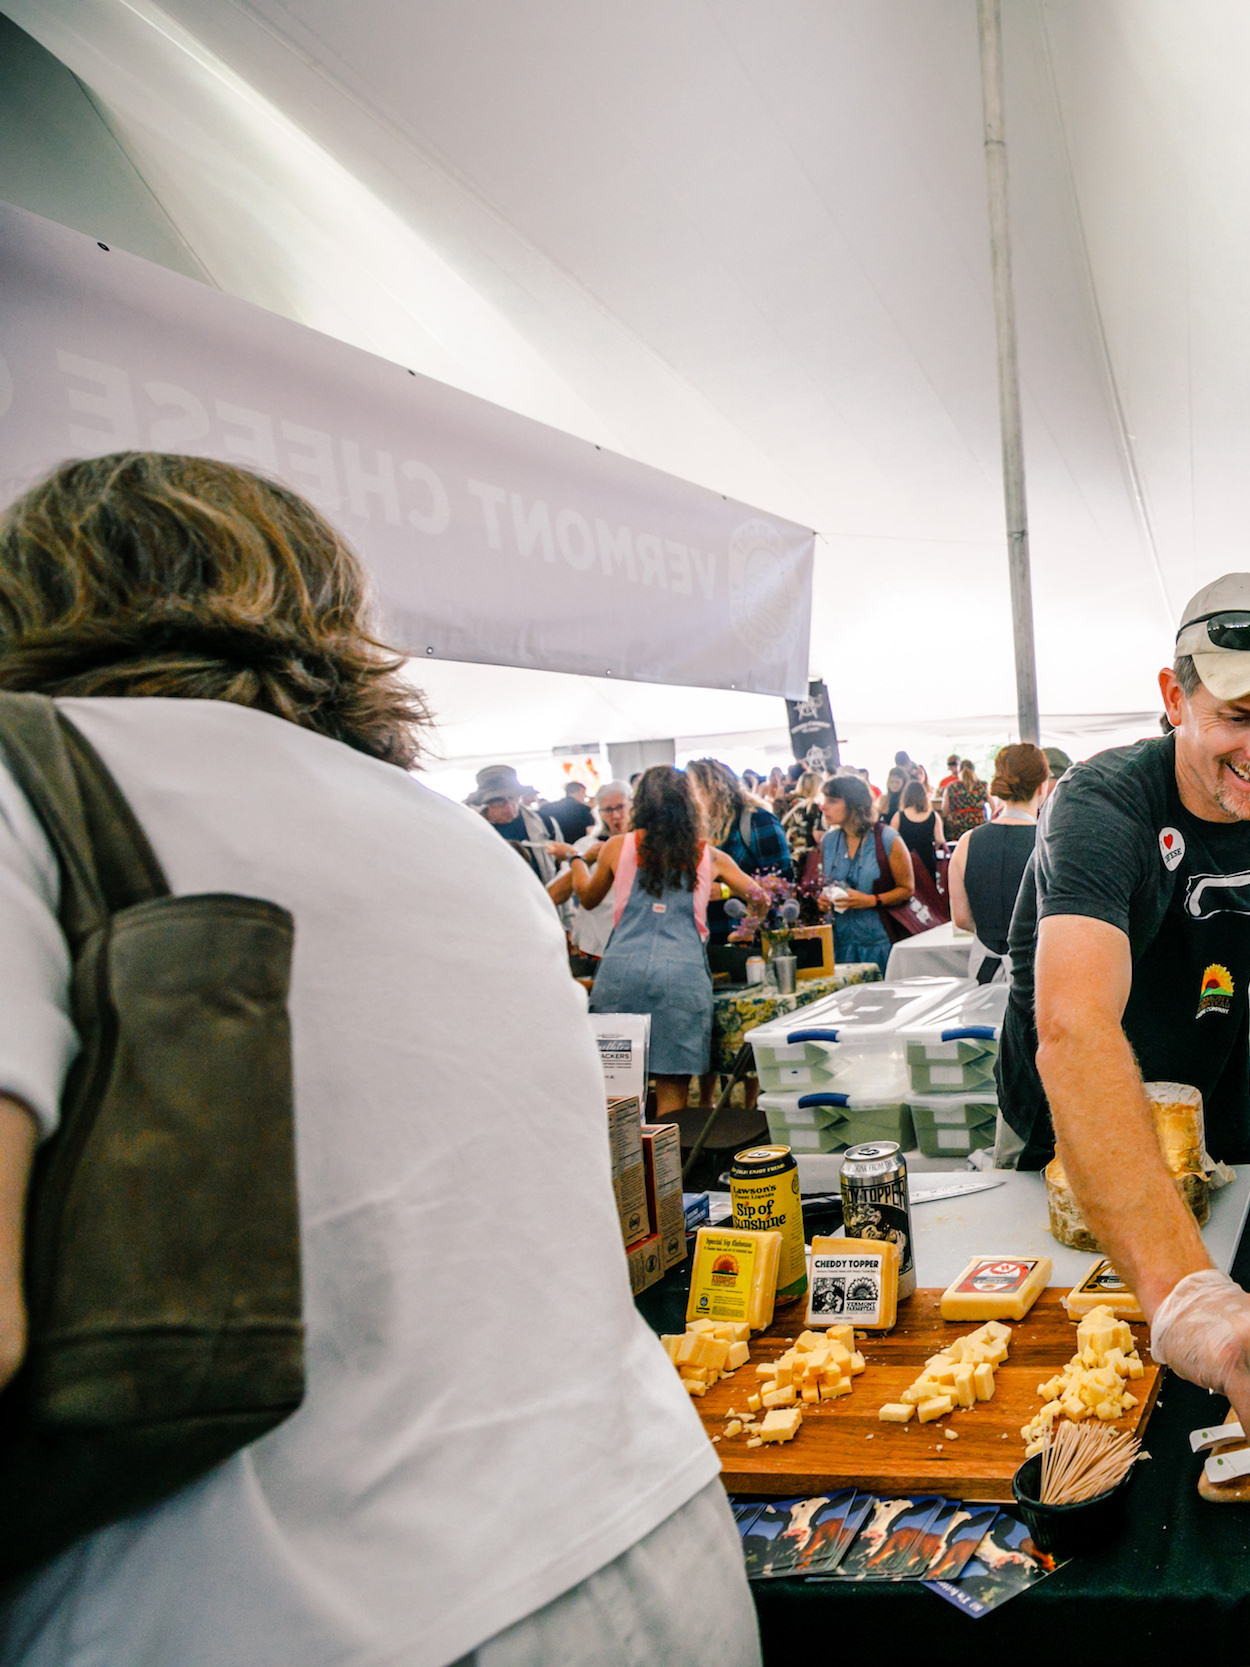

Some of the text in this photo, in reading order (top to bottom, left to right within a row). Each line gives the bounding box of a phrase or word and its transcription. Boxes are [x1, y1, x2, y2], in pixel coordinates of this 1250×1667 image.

[868, 1161, 884, 1172] FROM
[733, 1184, 777, 1194] Lawson's
[861, 1178, 905, 1209] TOPPER
[736, 1199, 775, 1219] Sip of
[734, 1213, 787, 1231] Sunshine
[815, 1260, 879, 1268] CHEDDY TOPPER
